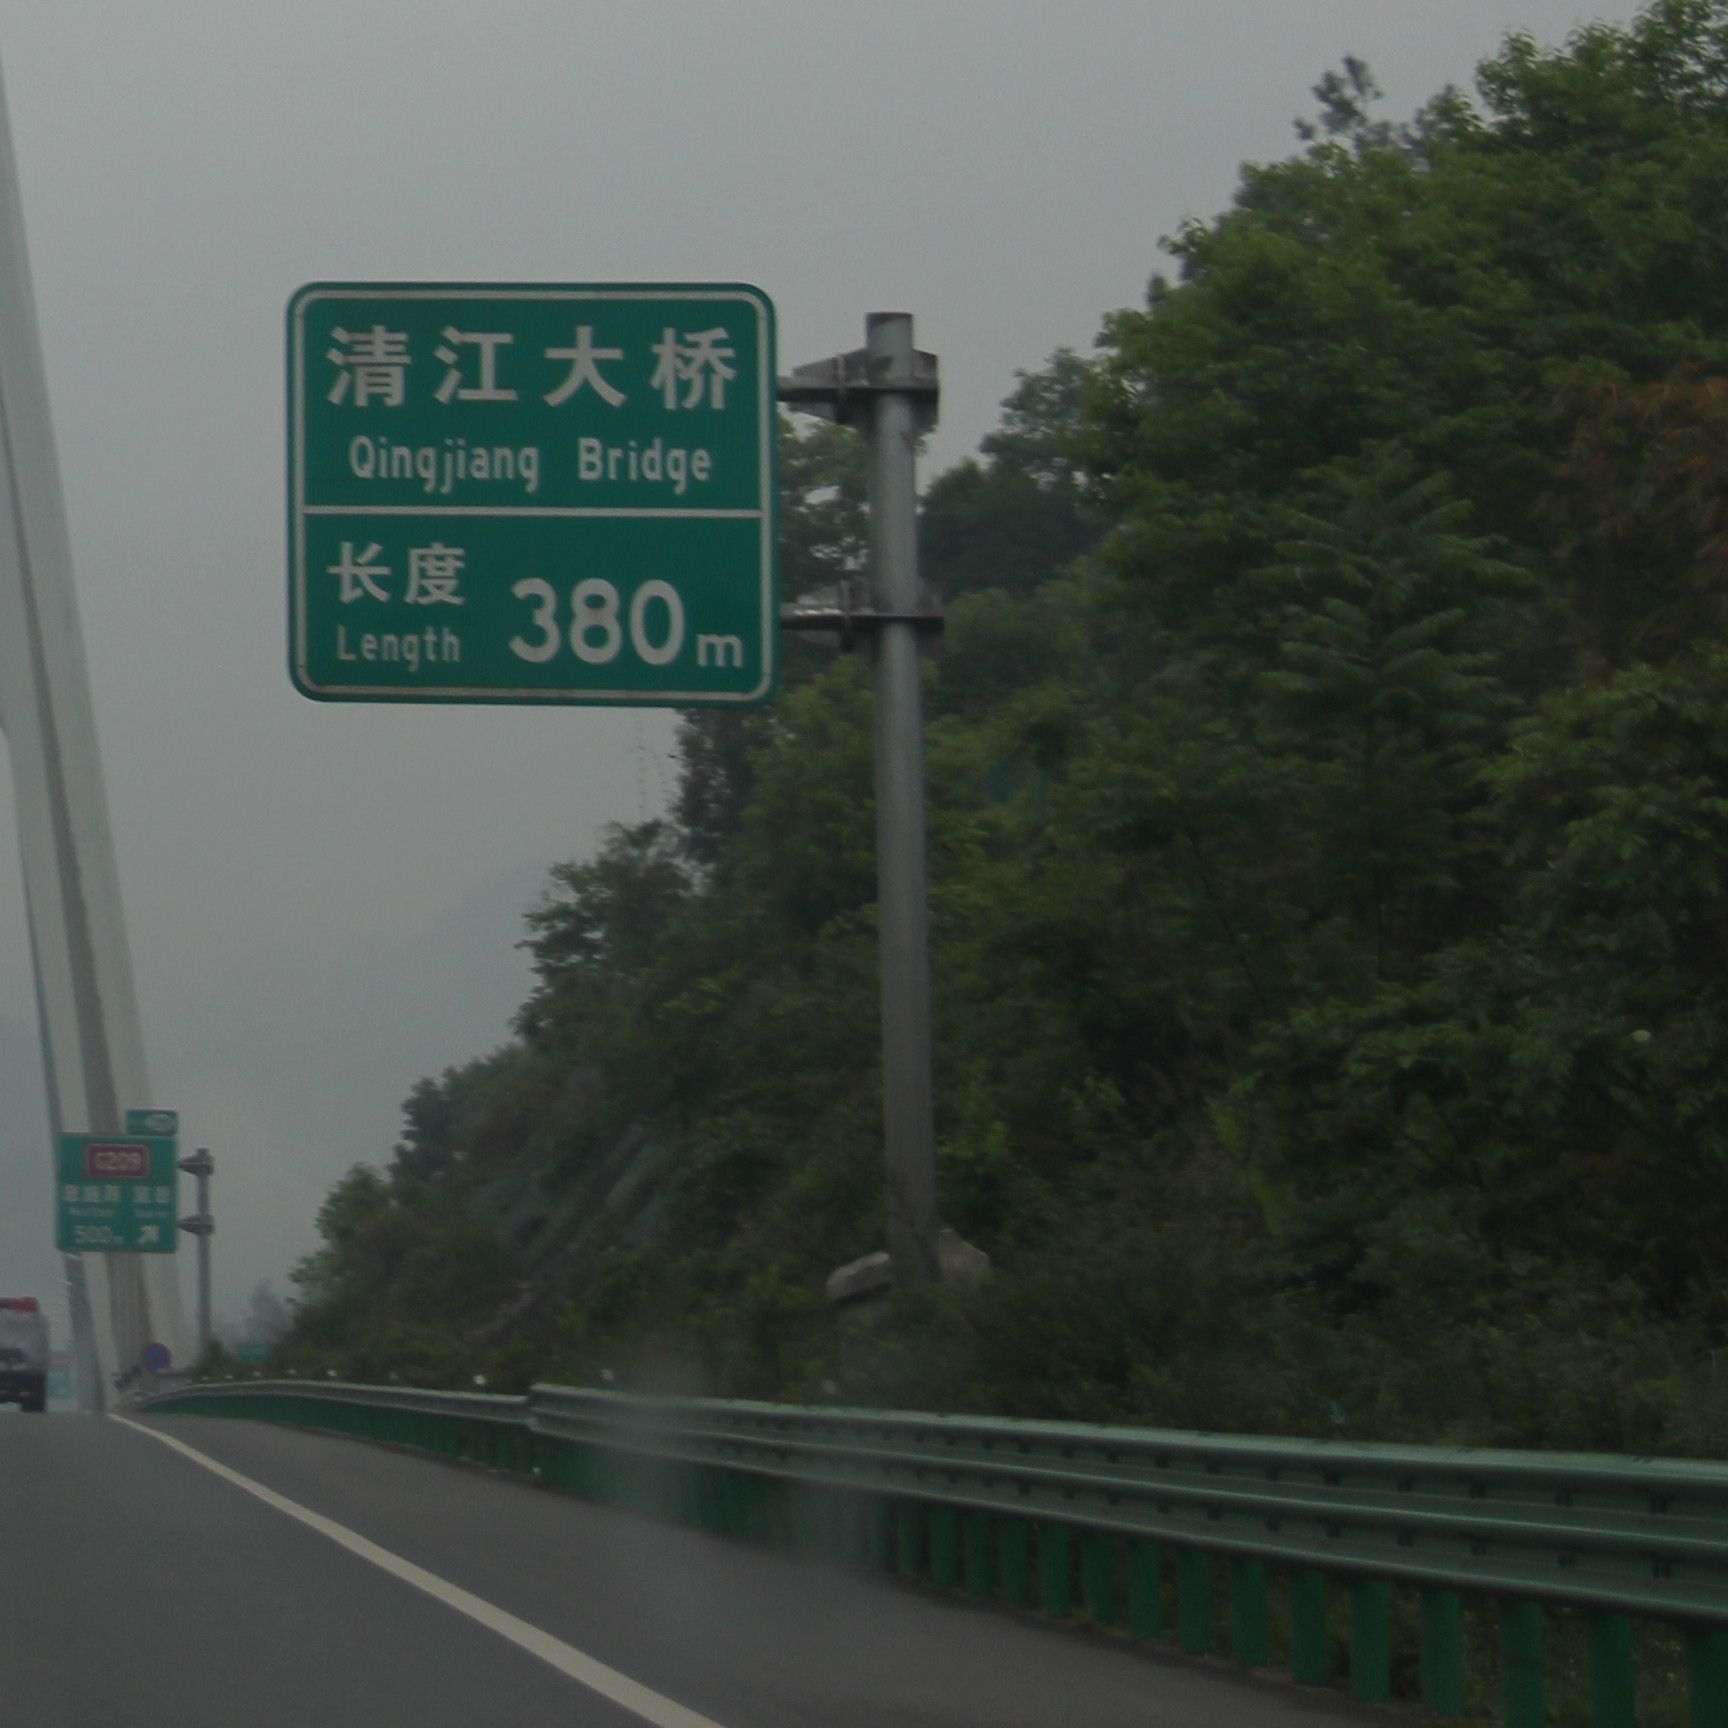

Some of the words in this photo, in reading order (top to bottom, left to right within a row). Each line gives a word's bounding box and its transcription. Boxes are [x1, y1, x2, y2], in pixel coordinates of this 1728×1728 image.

[326, 325, 737, 410] 清江大桥
[349, 435, 540, 494] Qingjiang
[577, 436, 712, 495] Bridge
[327, 541, 465, 606] 长度
[337, 624, 461, 672] Length
